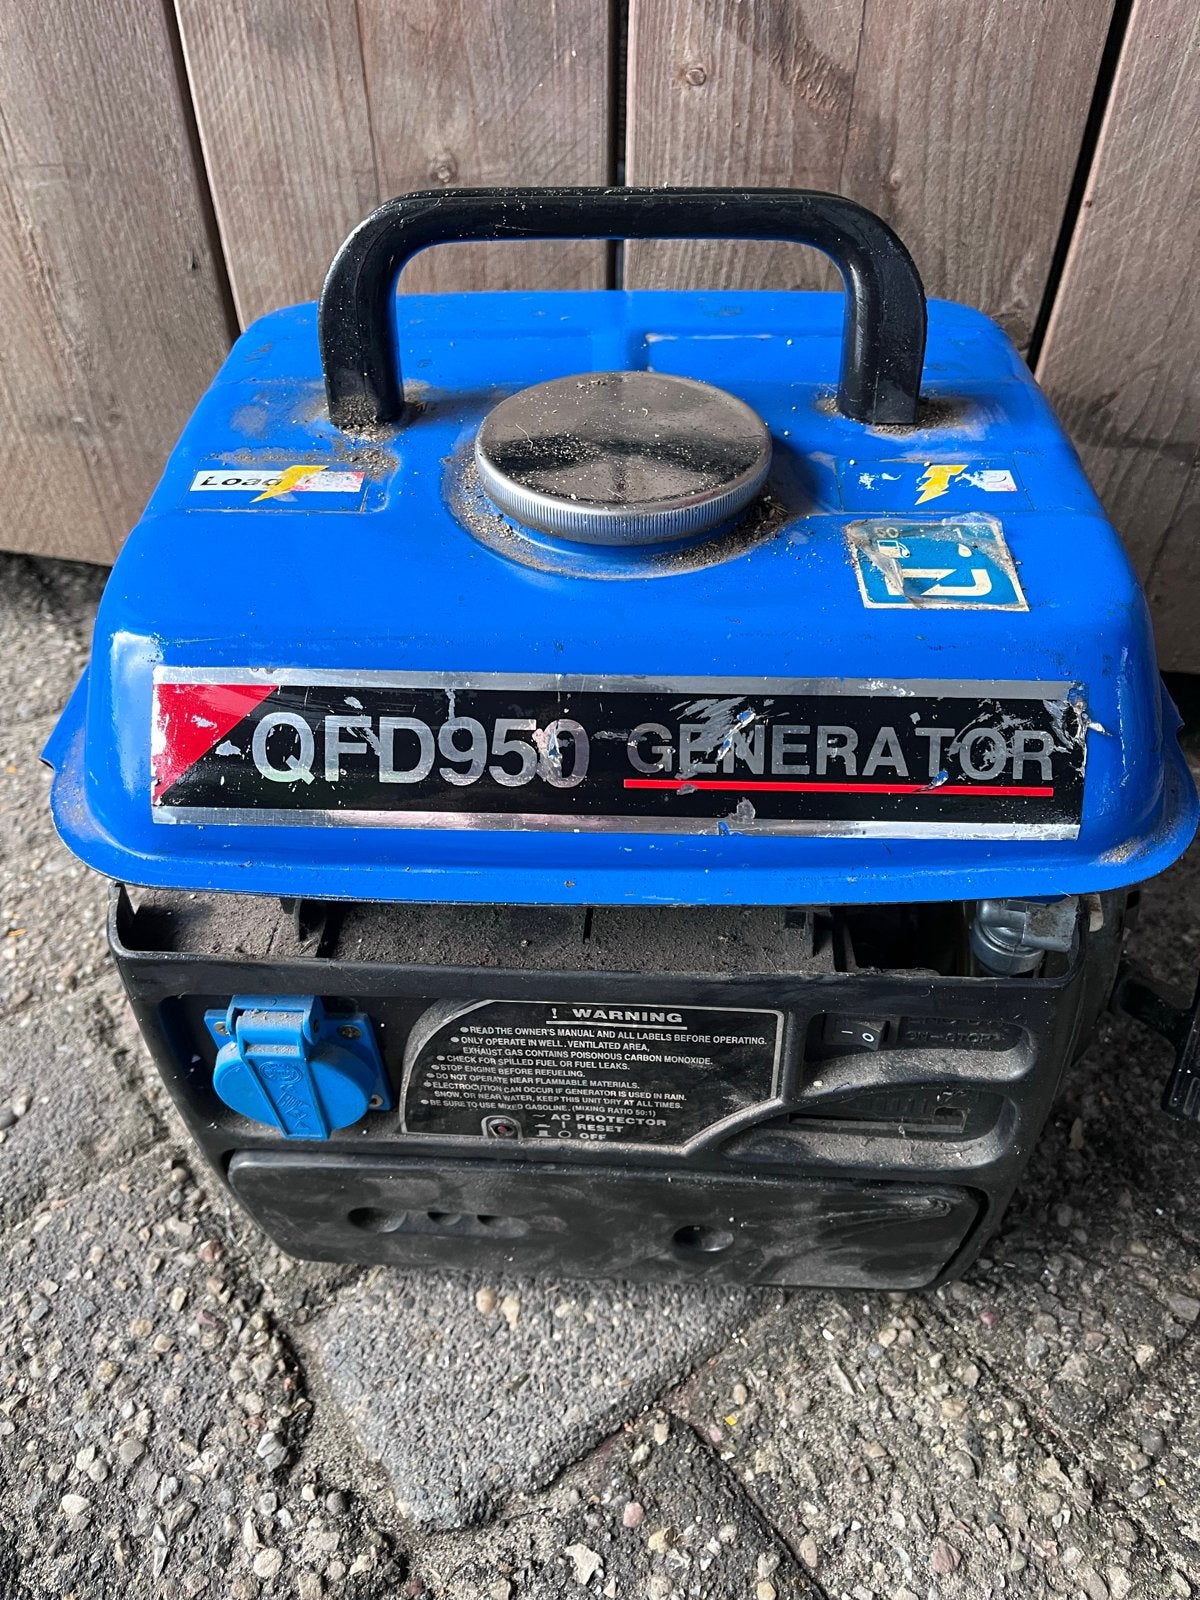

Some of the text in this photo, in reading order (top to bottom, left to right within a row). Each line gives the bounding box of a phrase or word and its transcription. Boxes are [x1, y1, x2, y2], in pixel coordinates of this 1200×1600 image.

[252, 712, 1053, 788] QFD950 GENERATOR
[572, 1008, 682, 1022] WARNING
[470, 1026, 494, 1034] READ
[514, 1027, 556, 1036] OWNER'S
[558, 1028, 594, 1037] MANUAL
[596, 1030, 616, 1038] AND
[618, 1032, 634, 1040] ALL
[636, 1032, 672, 1041] LABELS
[674, 1034, 711, 1042] BEFORE
[712, 1036, 768, 1044] OPERATING.
[486, 1038, 526, 1046] OPERATE
[622, 1043, 650, 1052] AREA,
[446, 1055, 477, 1063] CHECK
[498, 1058, 534, 1066] SPILLED
[598, 1062, 630, 1070] LEAKS.
[463, 1047, 502, 1056] EXHAUST
[525, 1050, 568, 1058] CONTAINS
[570, 1052, 622, 1060] POISONOUS
[624, 1054, 662, 1062] CARBON
[664, 1056, 713, 1064] MONOXIDE.
[464, 1066, 496, 1074] ENGINE
[498, 1067, 533, 1076] BEFORE
[535, 1068, 586, 1078] REFUELING.
[469, 1075, 508, 1084] OPERATE
[536, 1078, 588, 1086] FLAMMABLE
[590, 1080, 640, 1089] MATERIALS.
[432, 1082, 502, 1092] ELECTROCUTION
[565, 1088, 616, 1097] GENERATOR
[664, 1093, 687, 1101] RAIN.
[443, 1100, 466, 1108] SURE
[572, 1104, 606, 1112] (MIXING
[608, 1107, 634, 1115] RATIO
[636, 1110, 656, 1118] 50:1)
[576, 1114, 667, 1126] PROTECTOR
[576, 1123, 624, 1132] RESET
